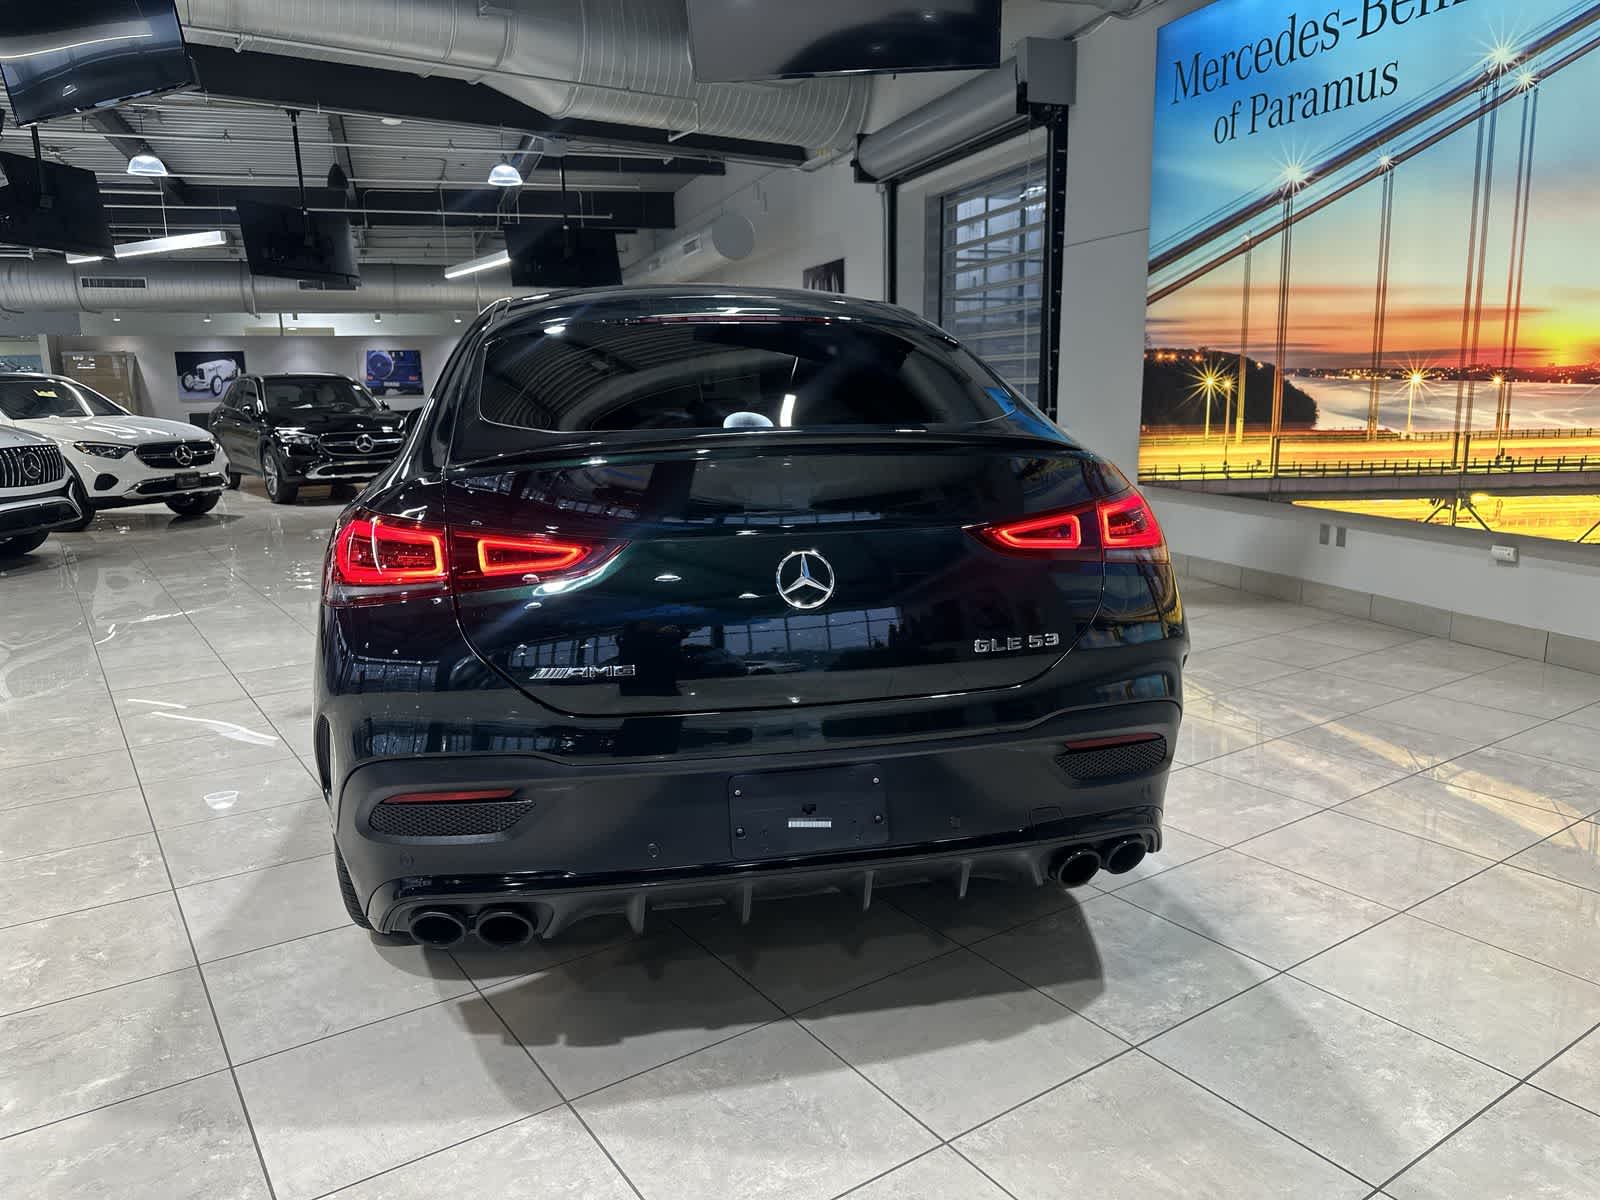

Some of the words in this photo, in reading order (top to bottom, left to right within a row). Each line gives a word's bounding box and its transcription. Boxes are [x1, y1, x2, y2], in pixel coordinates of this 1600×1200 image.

[1171, 0, 1468, 104] Mercedes-Be
[1214, 100, 1242, 144] of
[1248, 60, 1399, 135] Paramus
[974, 637, 1022, 653] GLE
[1028, 632, 1060, 648] 53
[563, 664, 636, 679] AMG
